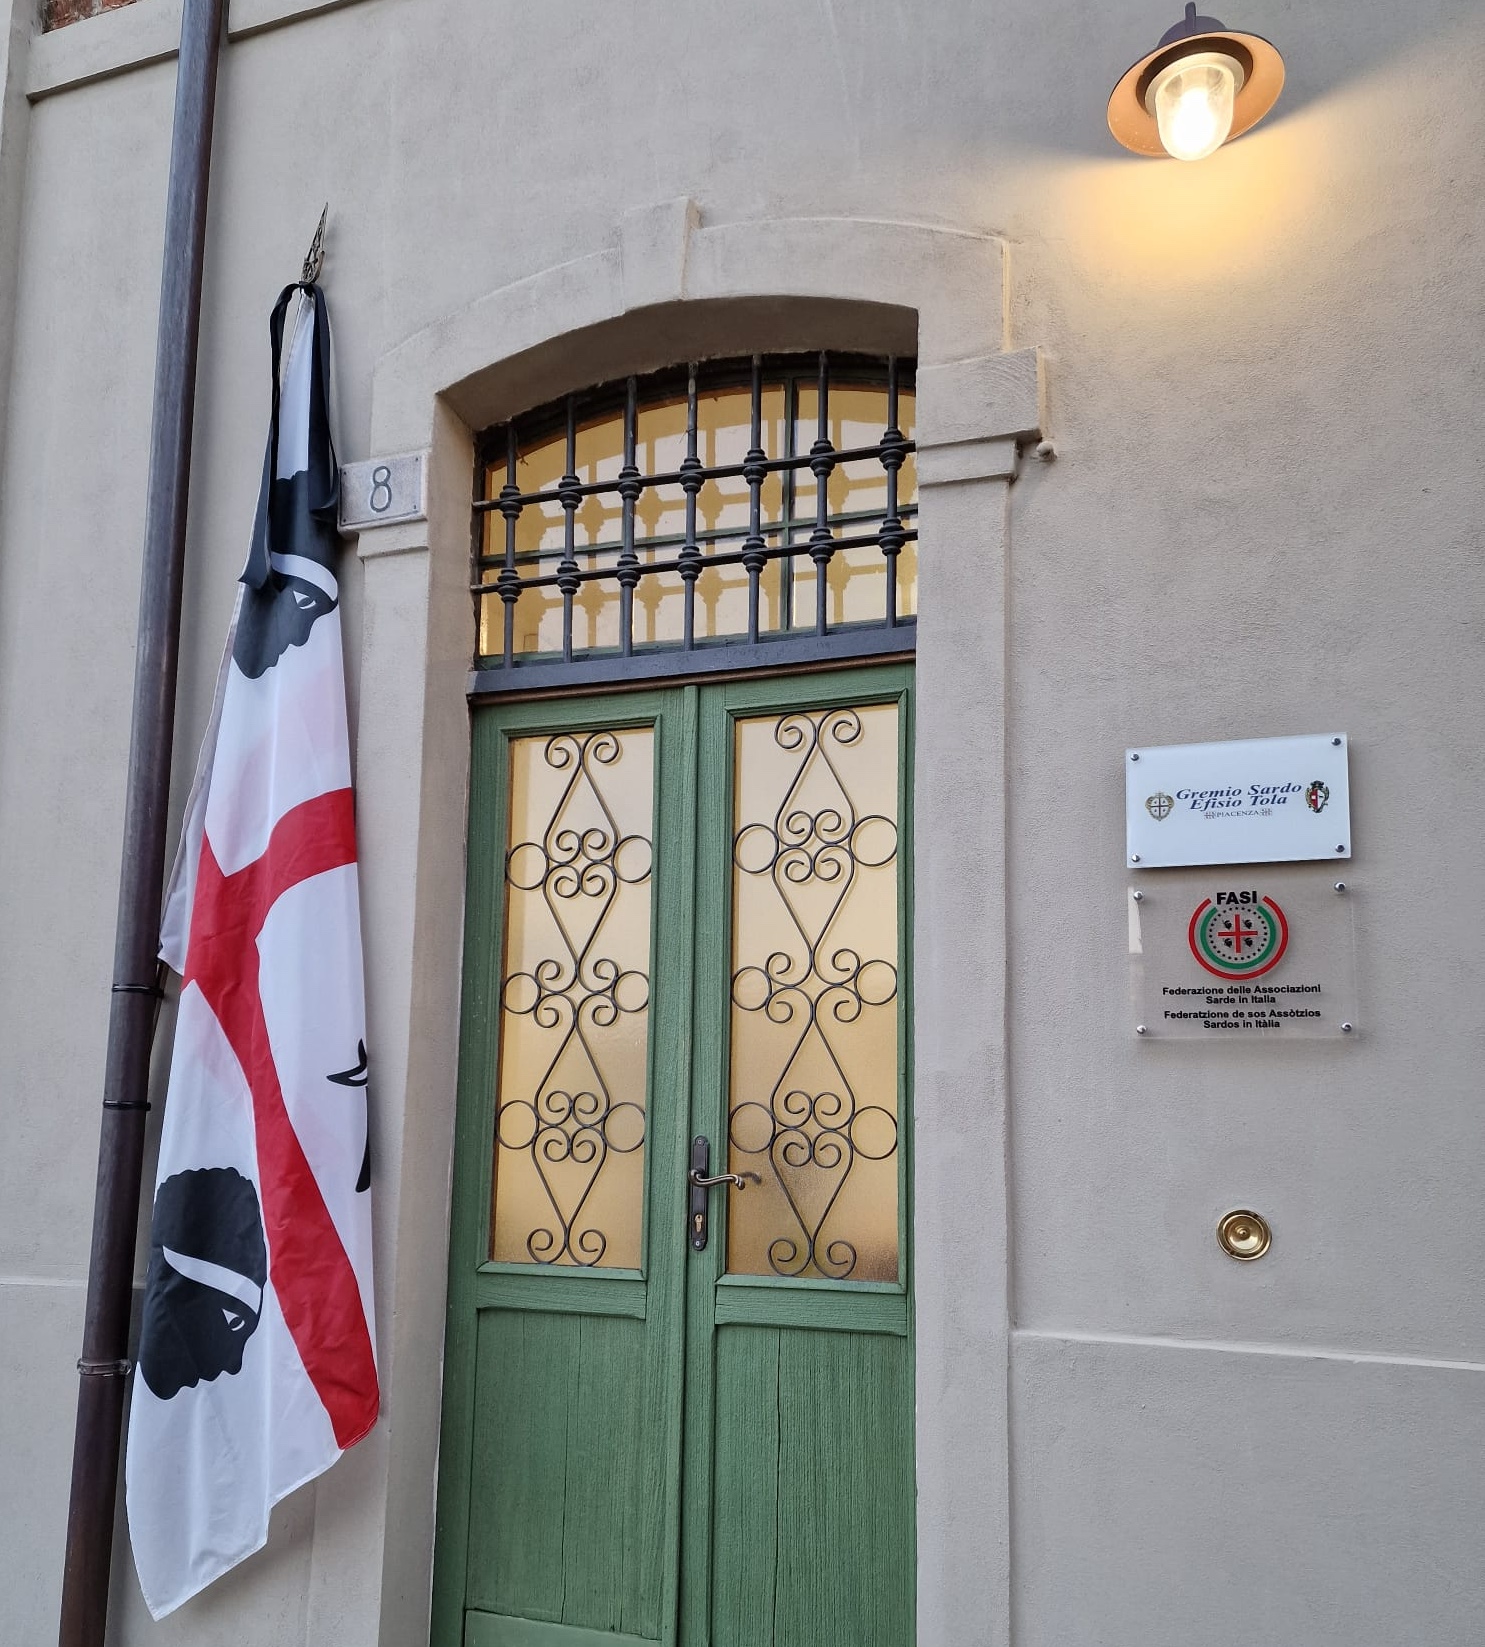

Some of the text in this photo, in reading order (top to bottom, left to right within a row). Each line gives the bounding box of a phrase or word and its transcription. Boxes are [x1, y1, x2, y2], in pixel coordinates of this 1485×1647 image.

[370, 465, 392, 513] 8
[1176, 782, 1302, 800] Gremio Sardo
[1190, 794, 1288, 812] Efisio Tola
[1216, 810, 1260, 818] PIACENZA
[1216, 890, 1258, 905] FASI
[1162, 984, 1321, 996] Federazione delle Associazioni
[1205, 995, 1276, 1004] Sarde in Italia
[1164, 1008, 1321, 1019] Federatzione de sos Assòtzios
[1203, 1019, 1280, 1029] Sardos in Itàlia
